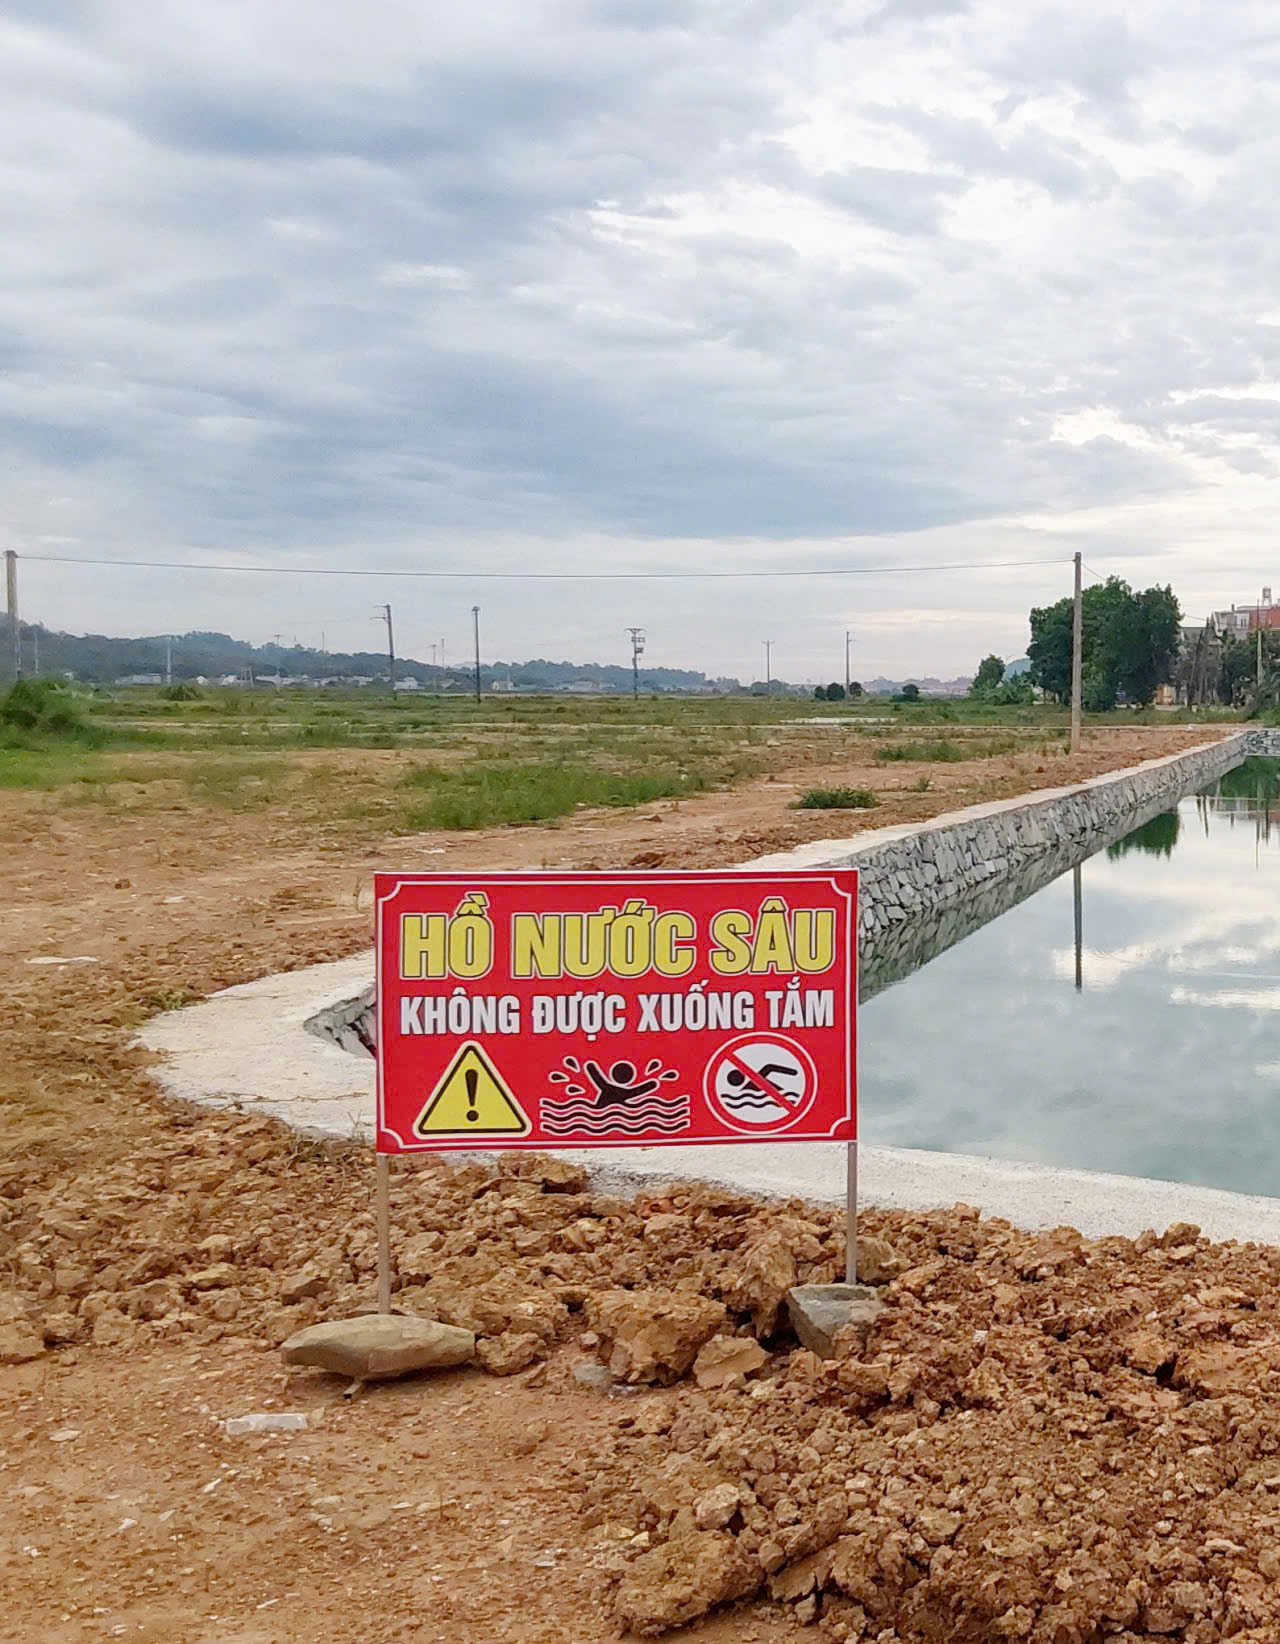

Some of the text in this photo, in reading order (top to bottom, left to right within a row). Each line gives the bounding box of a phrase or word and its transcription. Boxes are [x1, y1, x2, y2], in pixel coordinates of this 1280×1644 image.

[401, 892, 836, 979] HỒ NƯỚC SÂU
[400, 976, 834, 1042] KHÔNG ĐƯỢC XUỐNG TẮM
